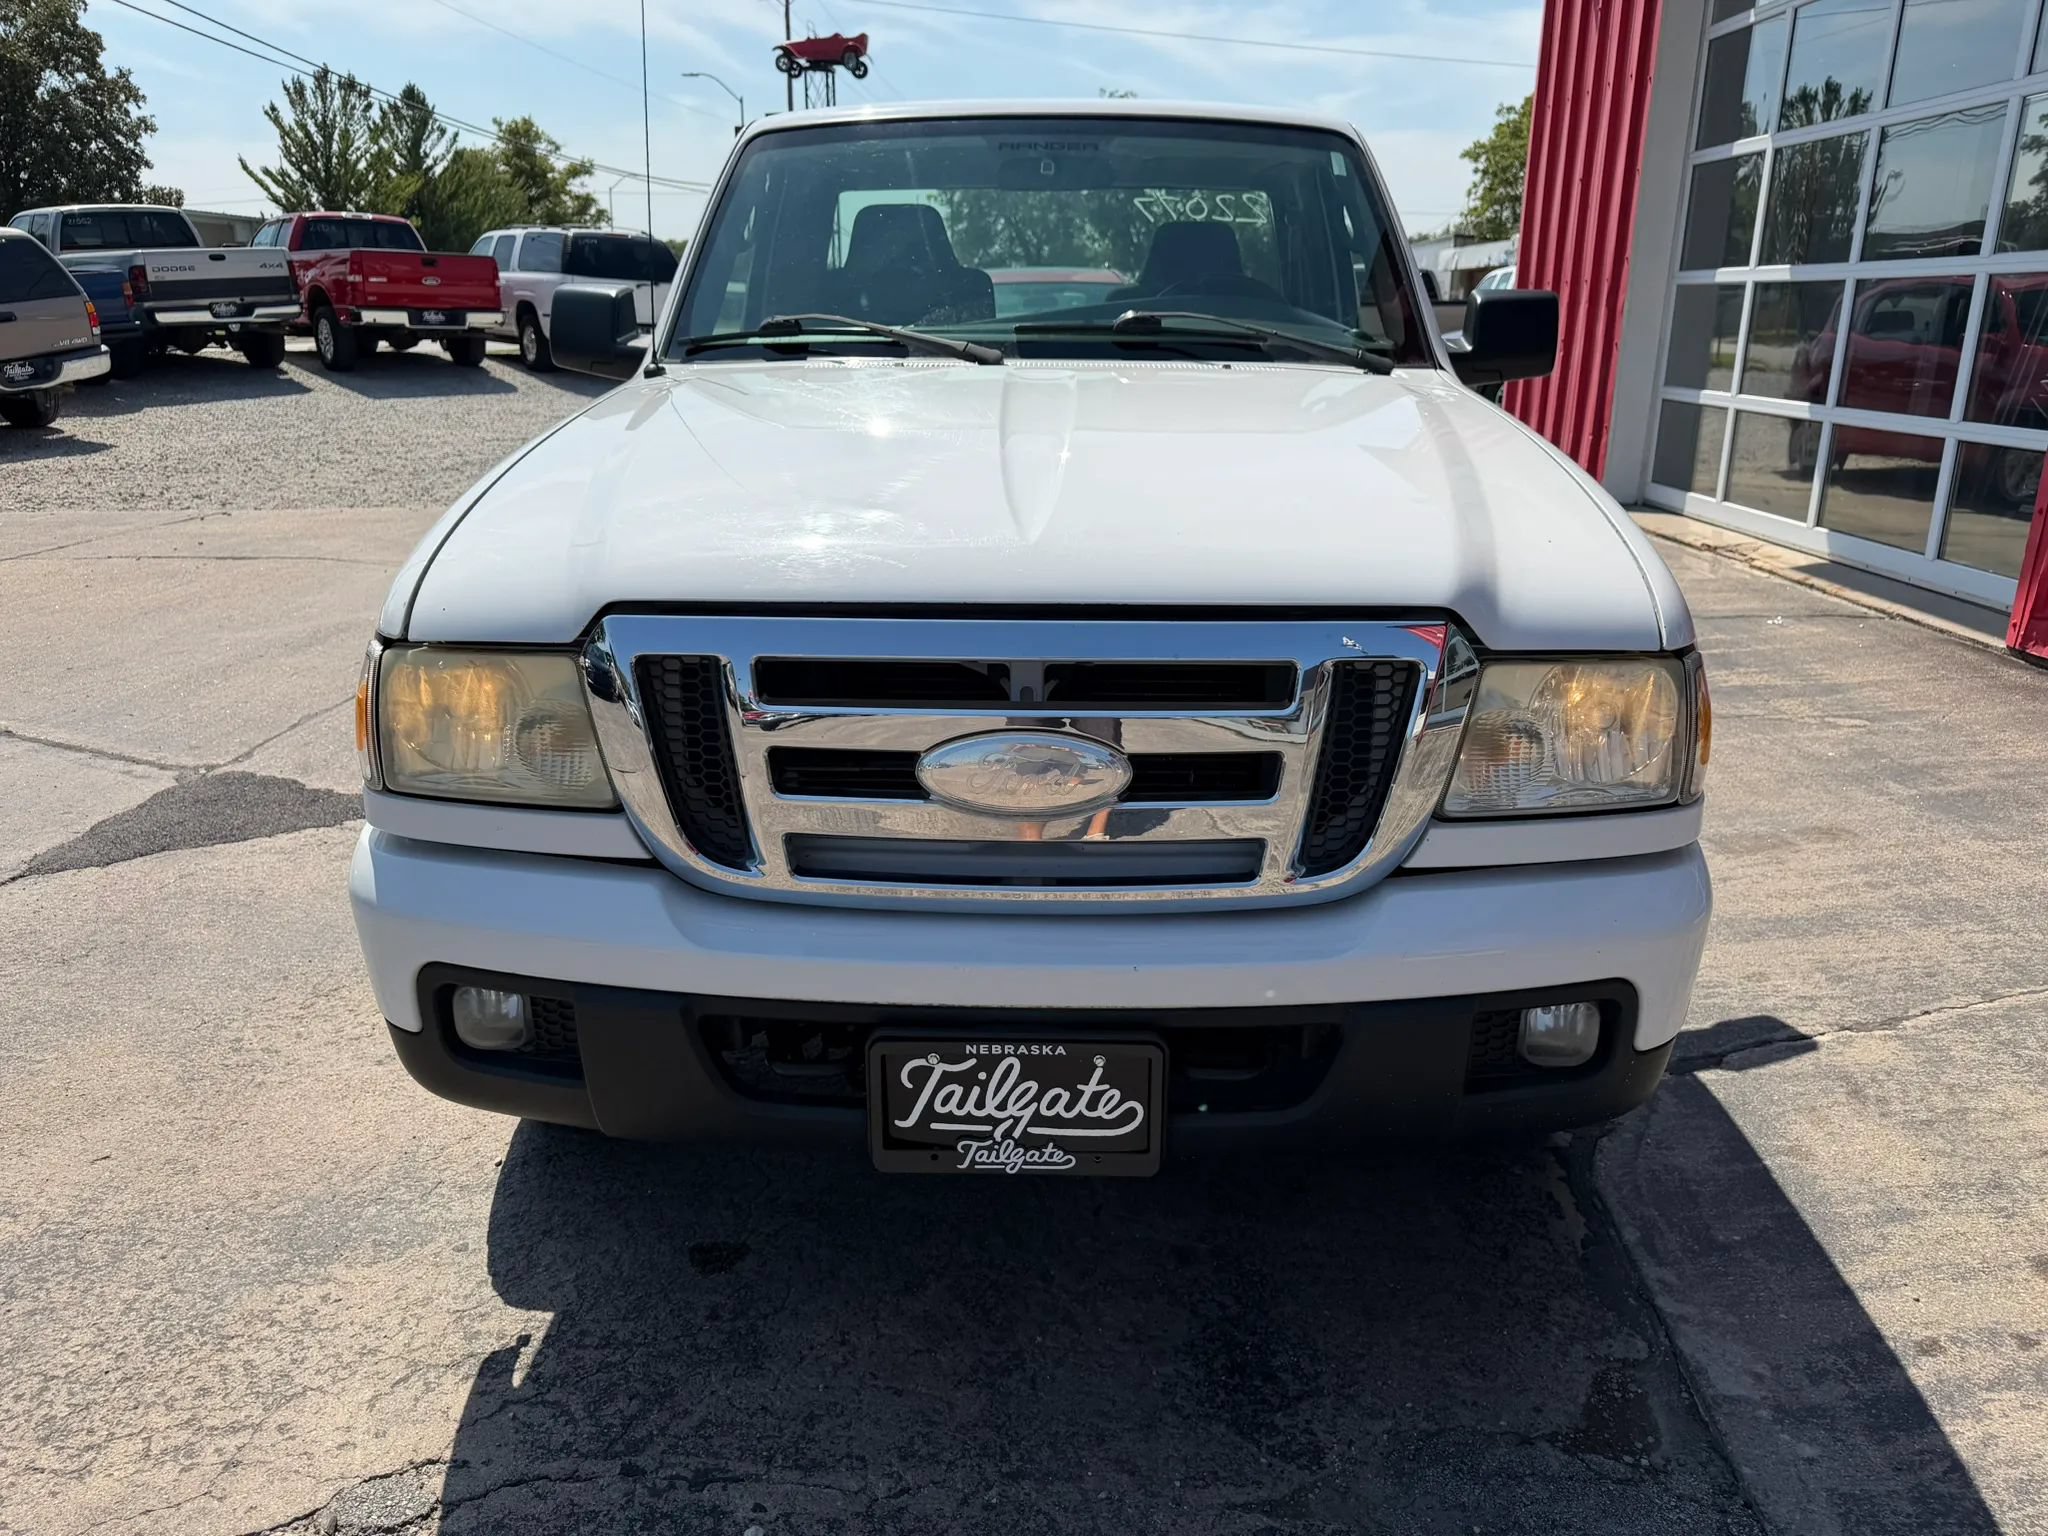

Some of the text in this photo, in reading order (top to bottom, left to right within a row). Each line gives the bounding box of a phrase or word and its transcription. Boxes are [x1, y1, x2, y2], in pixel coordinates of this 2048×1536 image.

[151, 264, 196, 273] DODGE
[965, 1043, 1068, 1056] NEBRASKA
[893, 1055, 1145, 1142] Tailgate
[956, 1138, 1077, 1175] Tailgate
